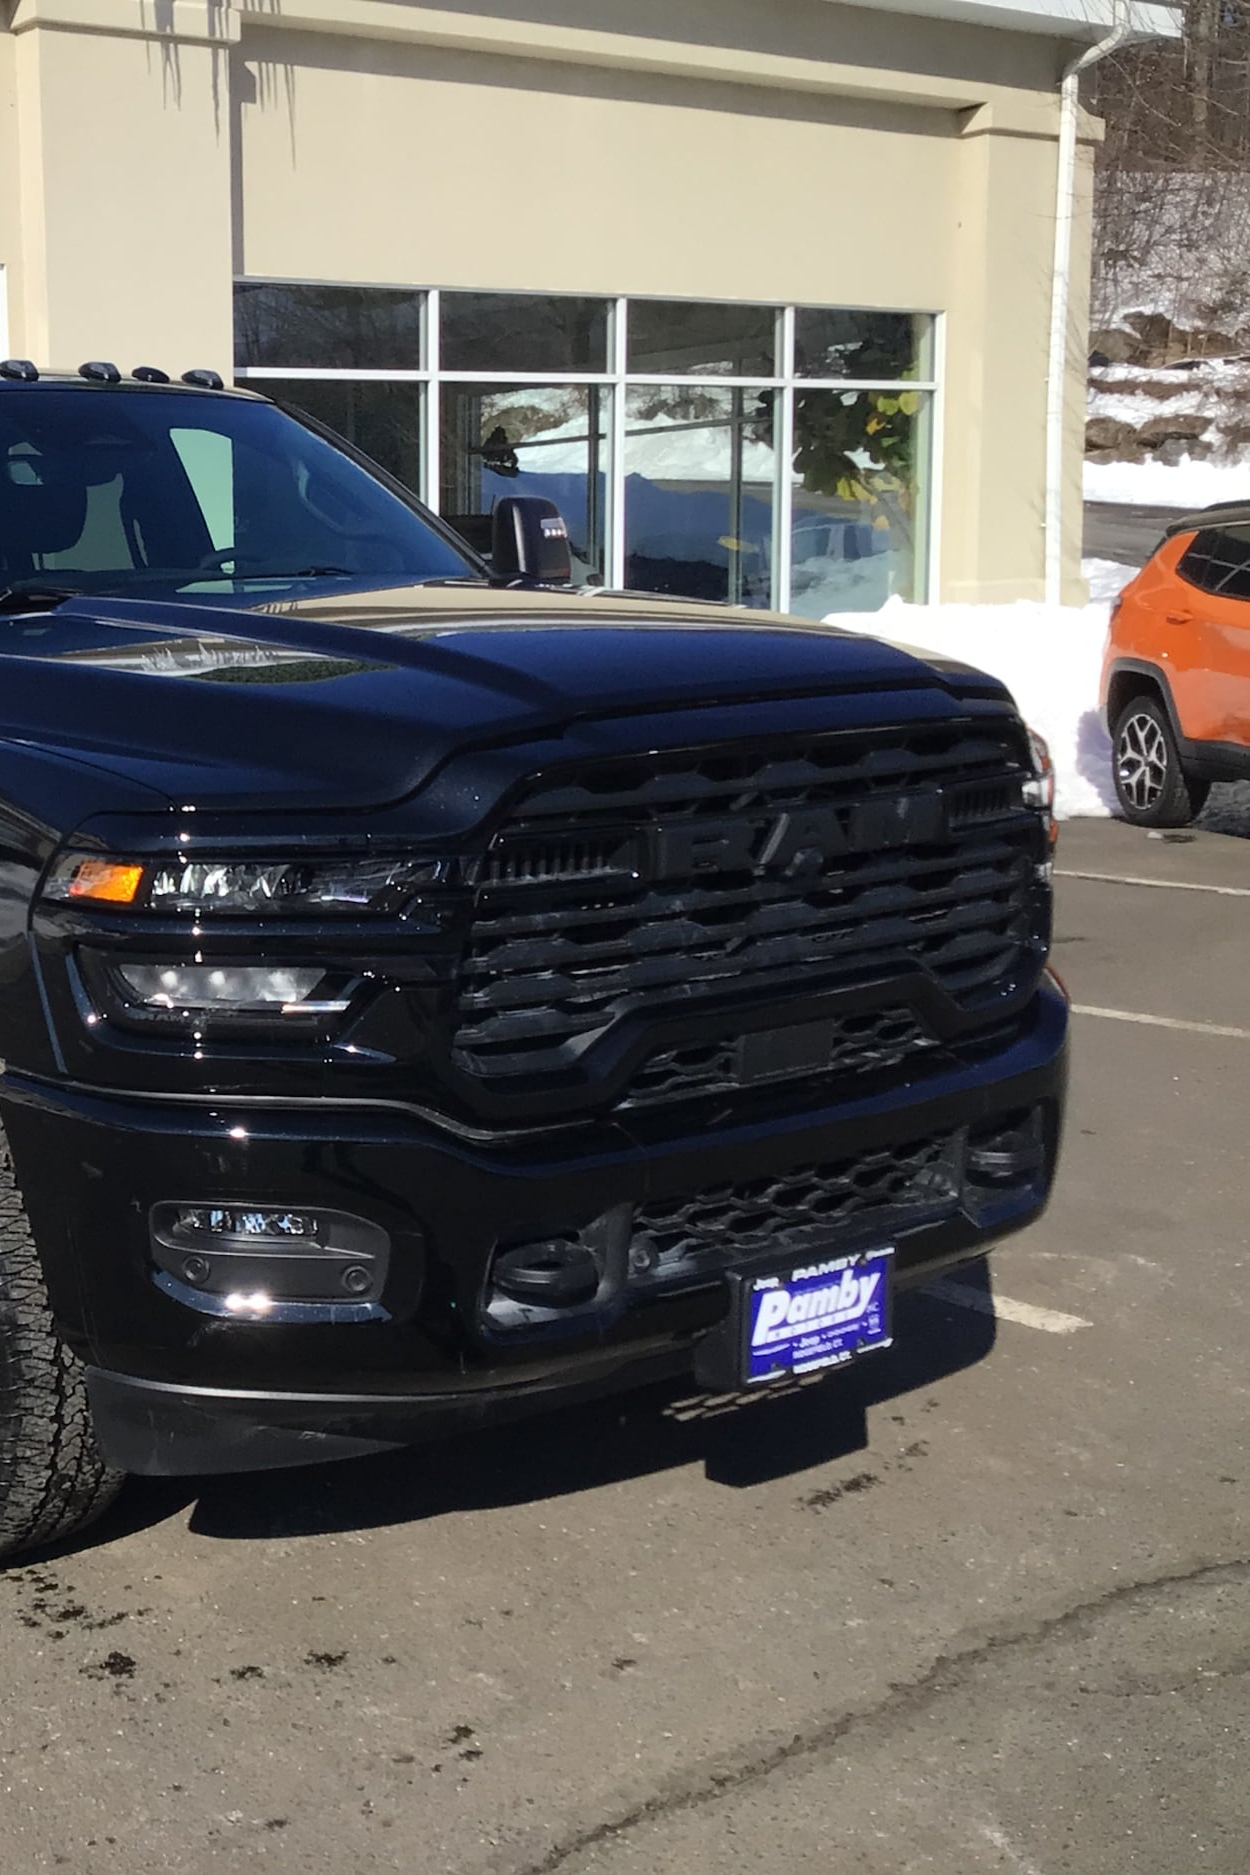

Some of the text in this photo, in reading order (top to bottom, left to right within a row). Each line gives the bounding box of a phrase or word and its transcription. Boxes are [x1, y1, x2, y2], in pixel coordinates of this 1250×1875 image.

[658, 792, 947, 880] RAM
[791, 1254, 861, 1282] PAMBY
[751, 1269, 881, 1347] Pamby
